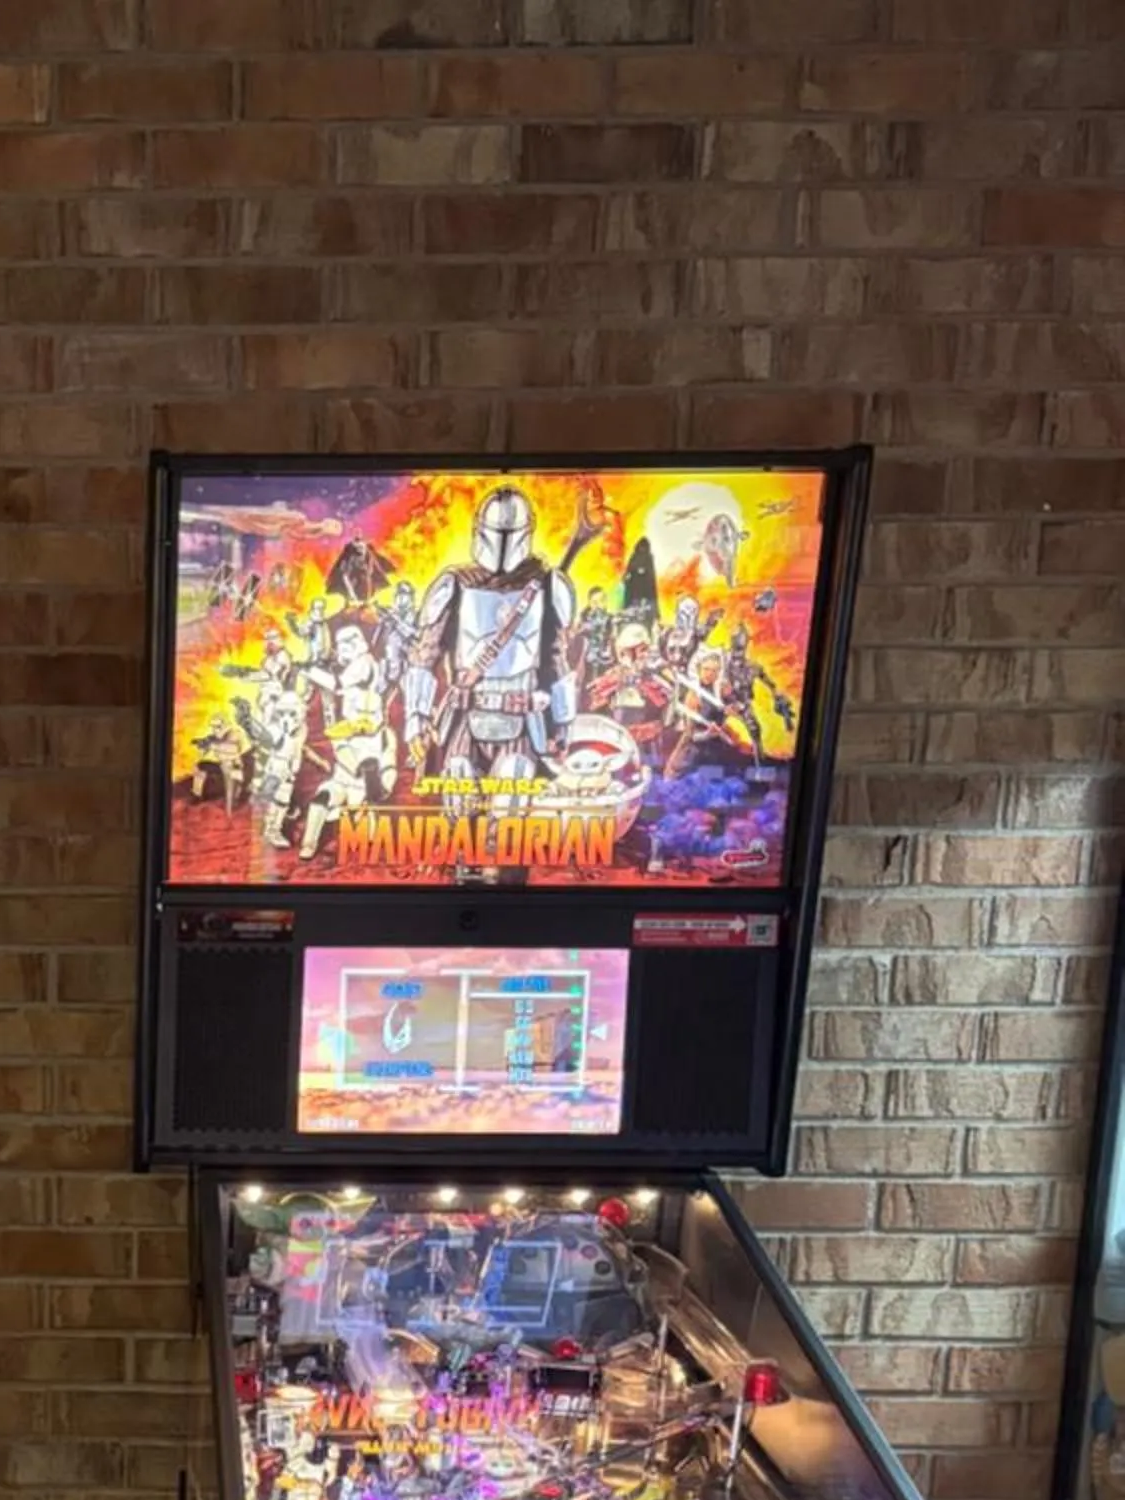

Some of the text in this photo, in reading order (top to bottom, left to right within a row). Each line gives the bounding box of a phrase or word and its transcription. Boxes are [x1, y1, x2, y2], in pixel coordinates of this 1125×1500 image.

[412, 777, 549, 796] STAR WARS
[336, 813, 615, 866] MANDALORIAN
